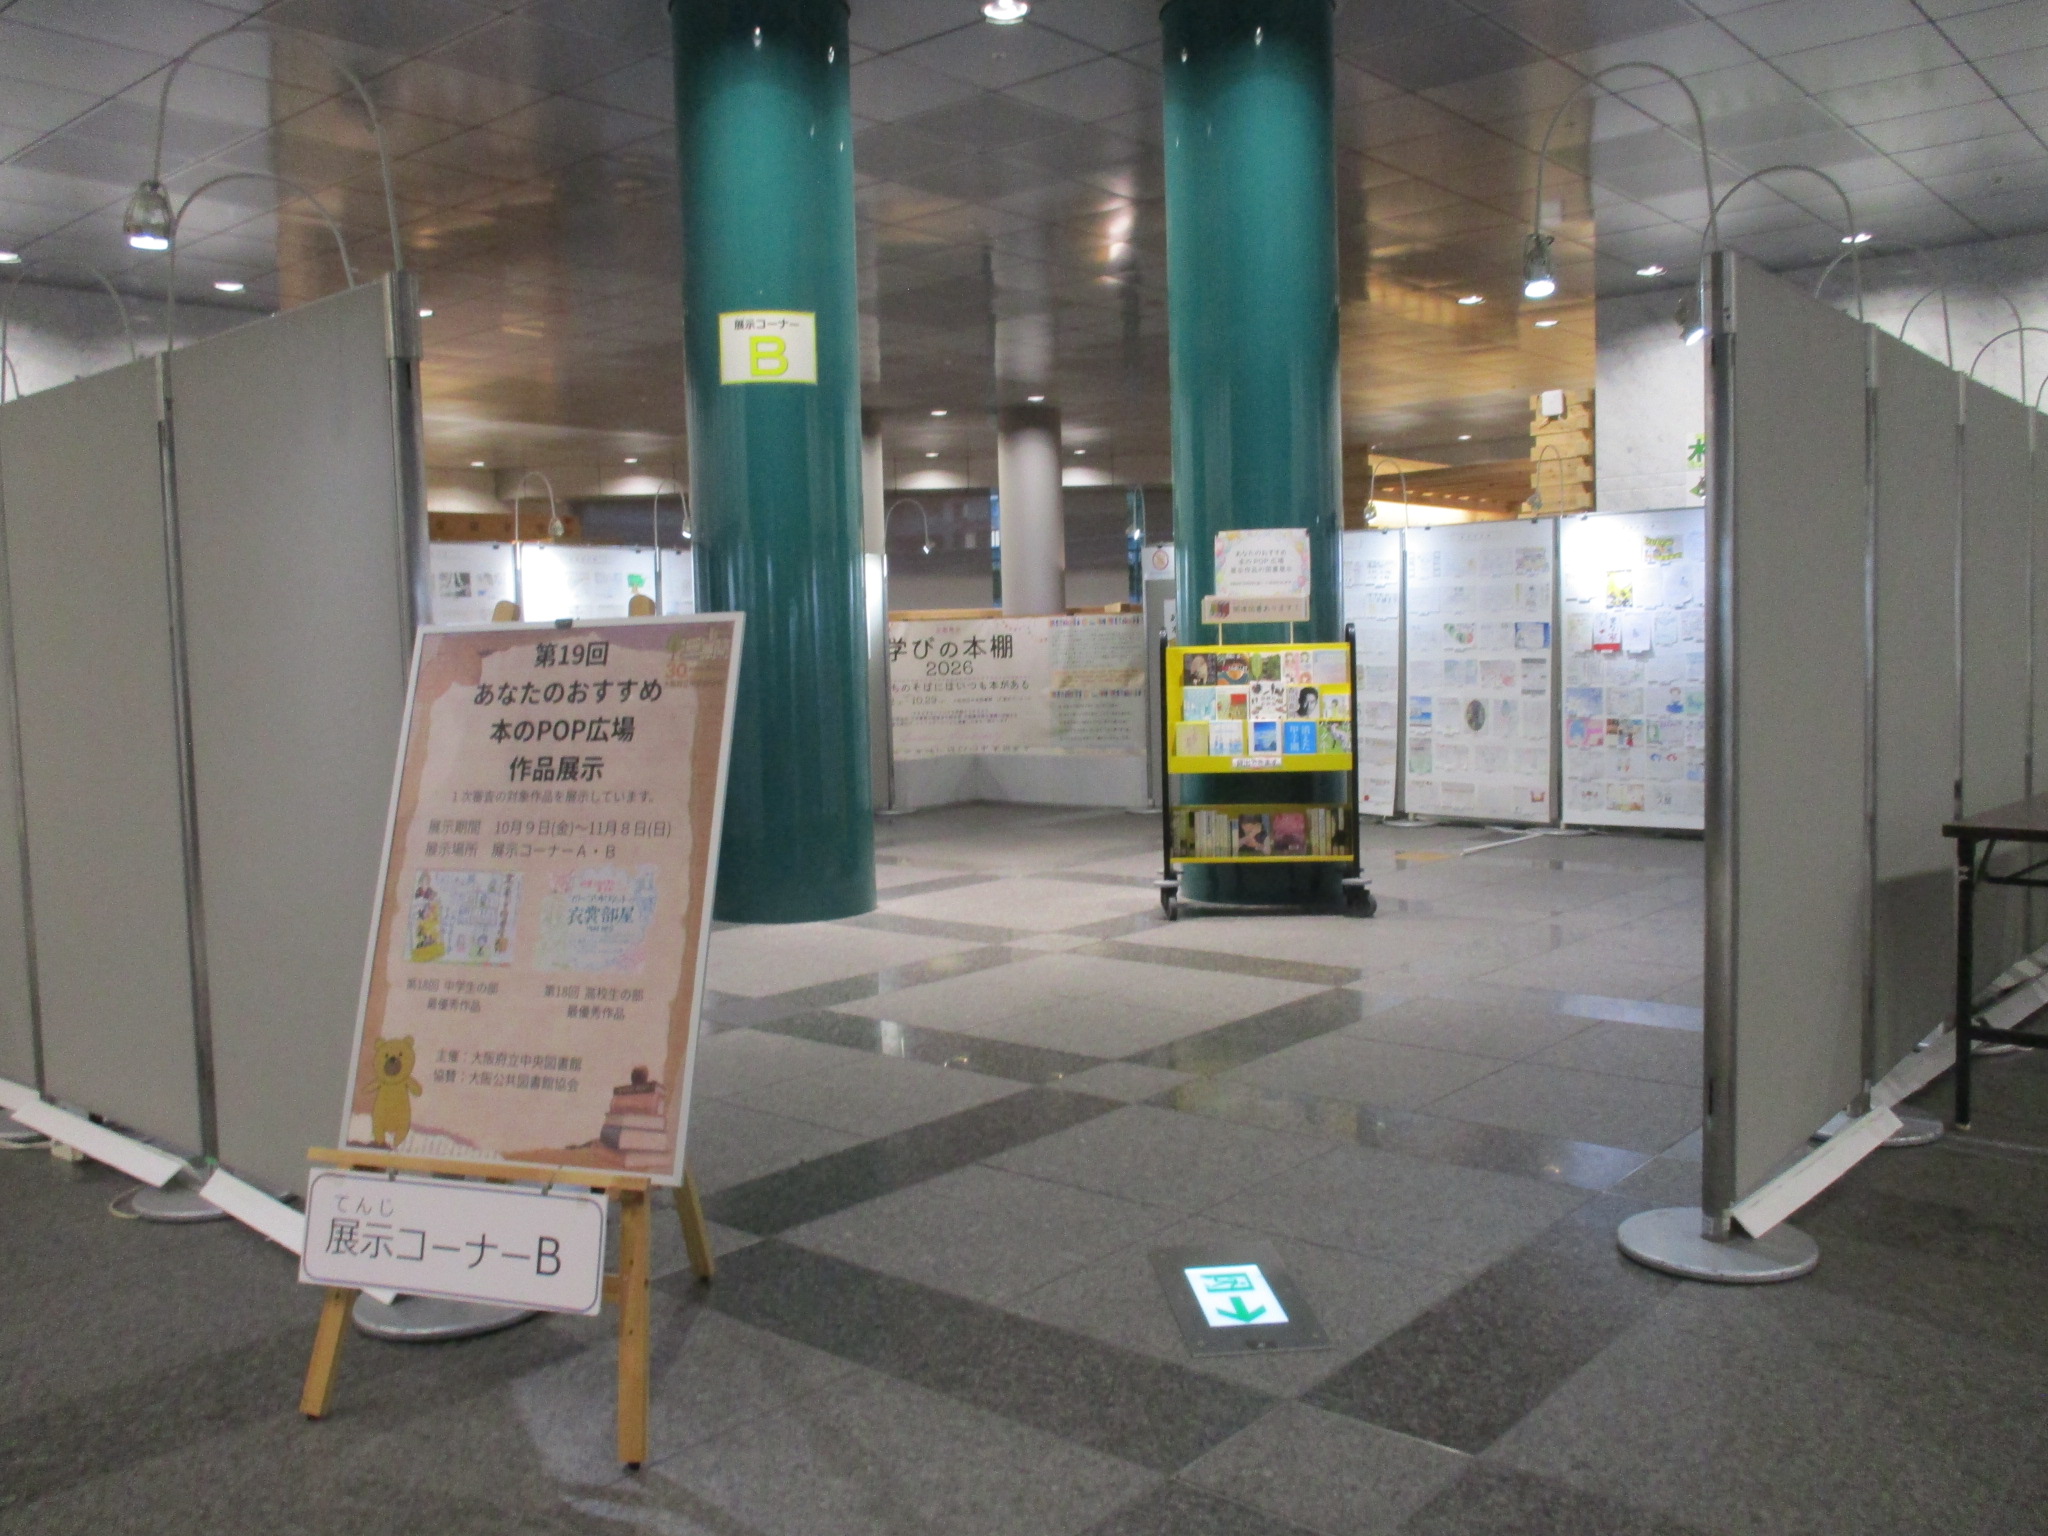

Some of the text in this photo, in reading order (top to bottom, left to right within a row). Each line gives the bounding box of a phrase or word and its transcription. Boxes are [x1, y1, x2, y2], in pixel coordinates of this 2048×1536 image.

[734, 318, 800, 331] 展示コーナー
[749, 335, 789, 376] B
[535, 641, 610, 667] 第19回
[889, 634, 1013, 662] 学びの本棚
[926, 660, 974, 677] 2026
[473, 678, 663, 706] あなたのおすすめ
[489, 715, 635, 743] 本のPOP広場
[510, 756, 605, 783] 作品展示
[427, 818, 482, 835] 展示期間
[424, 841, 478, 858] 展示場所
[406, 977, 440, 993] 第18回
[544, 984, 580, 999] 第18回
[335, 1193, 394, 1217] てんじ
[326, 1217, 562, 1277] 展示コーナーB
